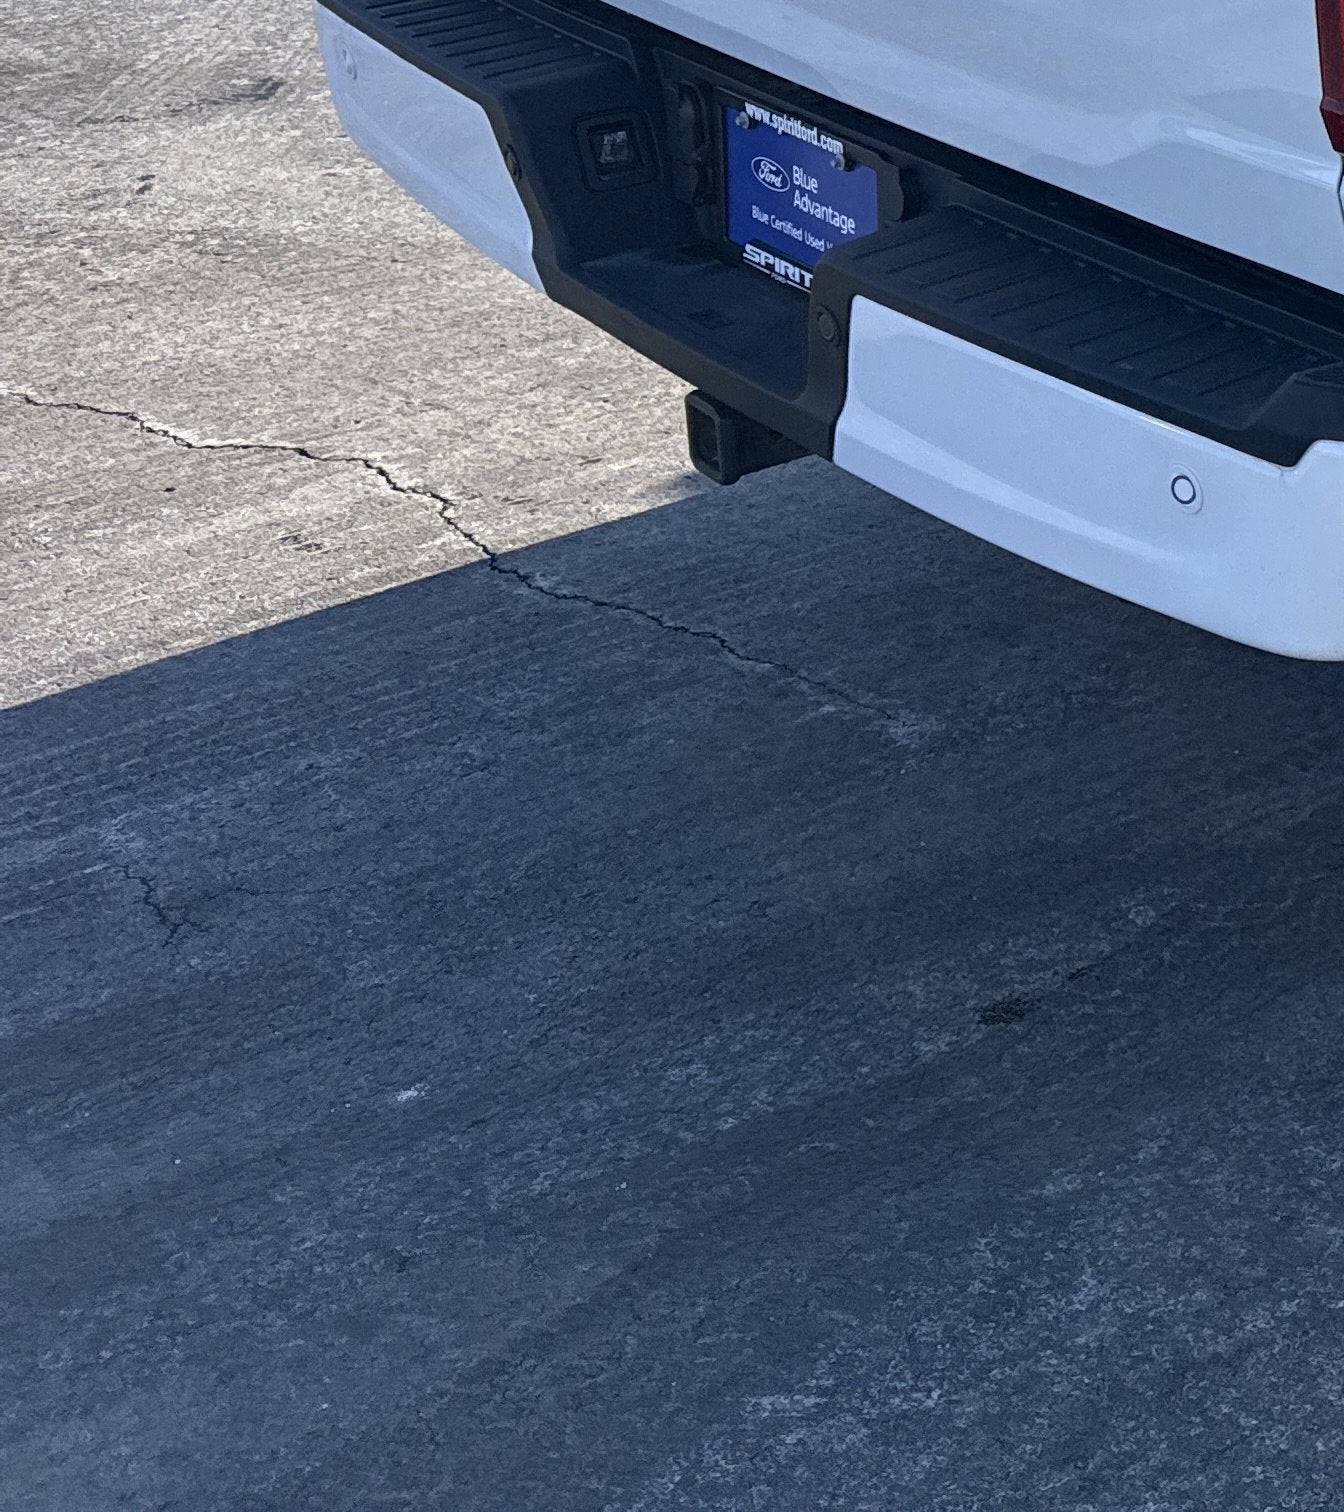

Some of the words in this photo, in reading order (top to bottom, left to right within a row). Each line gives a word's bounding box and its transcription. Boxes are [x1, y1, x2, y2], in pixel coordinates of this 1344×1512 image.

[744, 102, 844, 155] www.spiritford.com
[757, 160, 784, 189] Ford
[792, 165, 818, 194] Blue
[751, 205, 769, 225] Blue
[770, 214, 802, 242] Certified
[804, 230, 825, 252] Used
[793, 190, 856, 235] Advantage
[743, 243, 814, 288] SPIRIT
